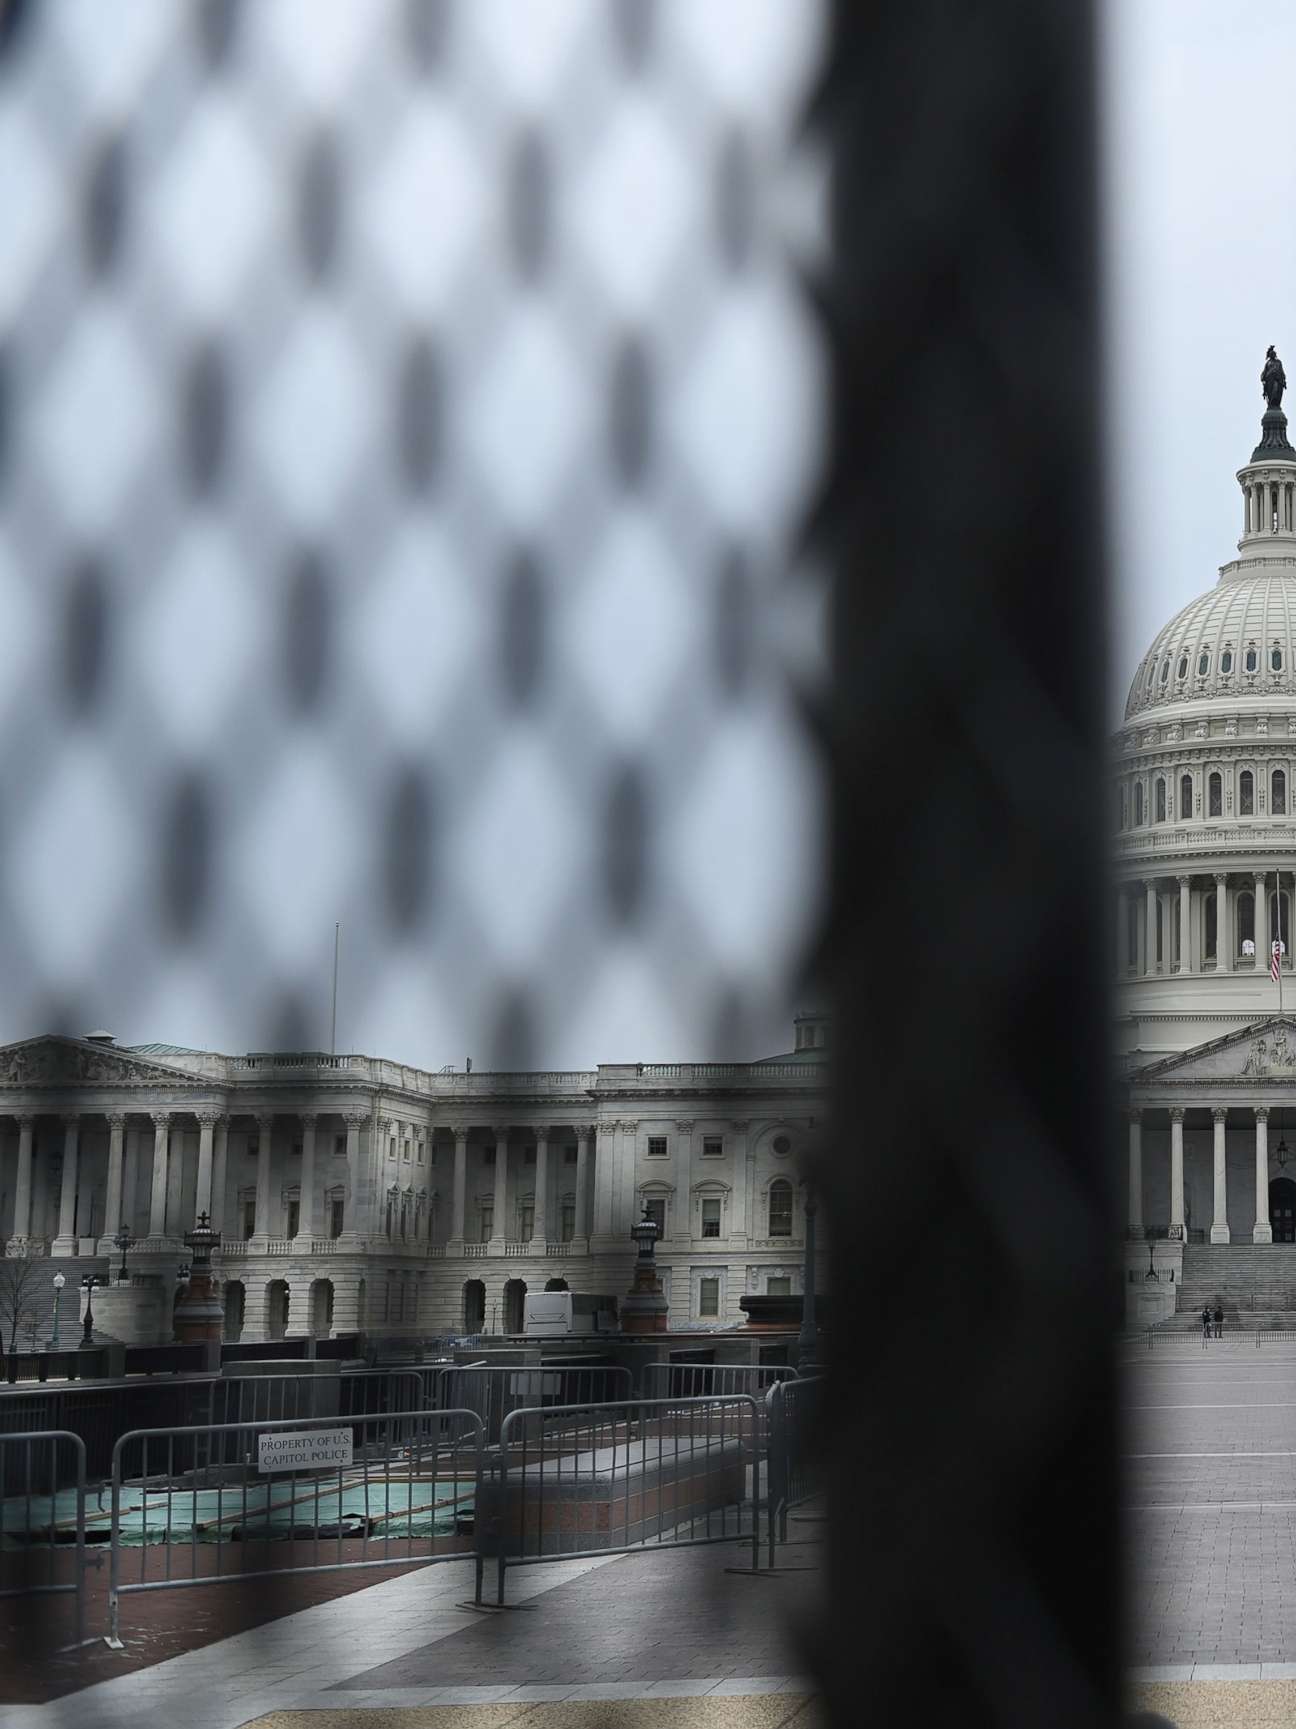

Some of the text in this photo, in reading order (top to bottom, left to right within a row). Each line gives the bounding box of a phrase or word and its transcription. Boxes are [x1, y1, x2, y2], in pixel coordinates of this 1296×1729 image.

[261, 1438, 314, 1450] PROPERTY
[317, 1436, 331, 1446] OF
[263, 1449, 348, 1465] CAPITOL POLICE
